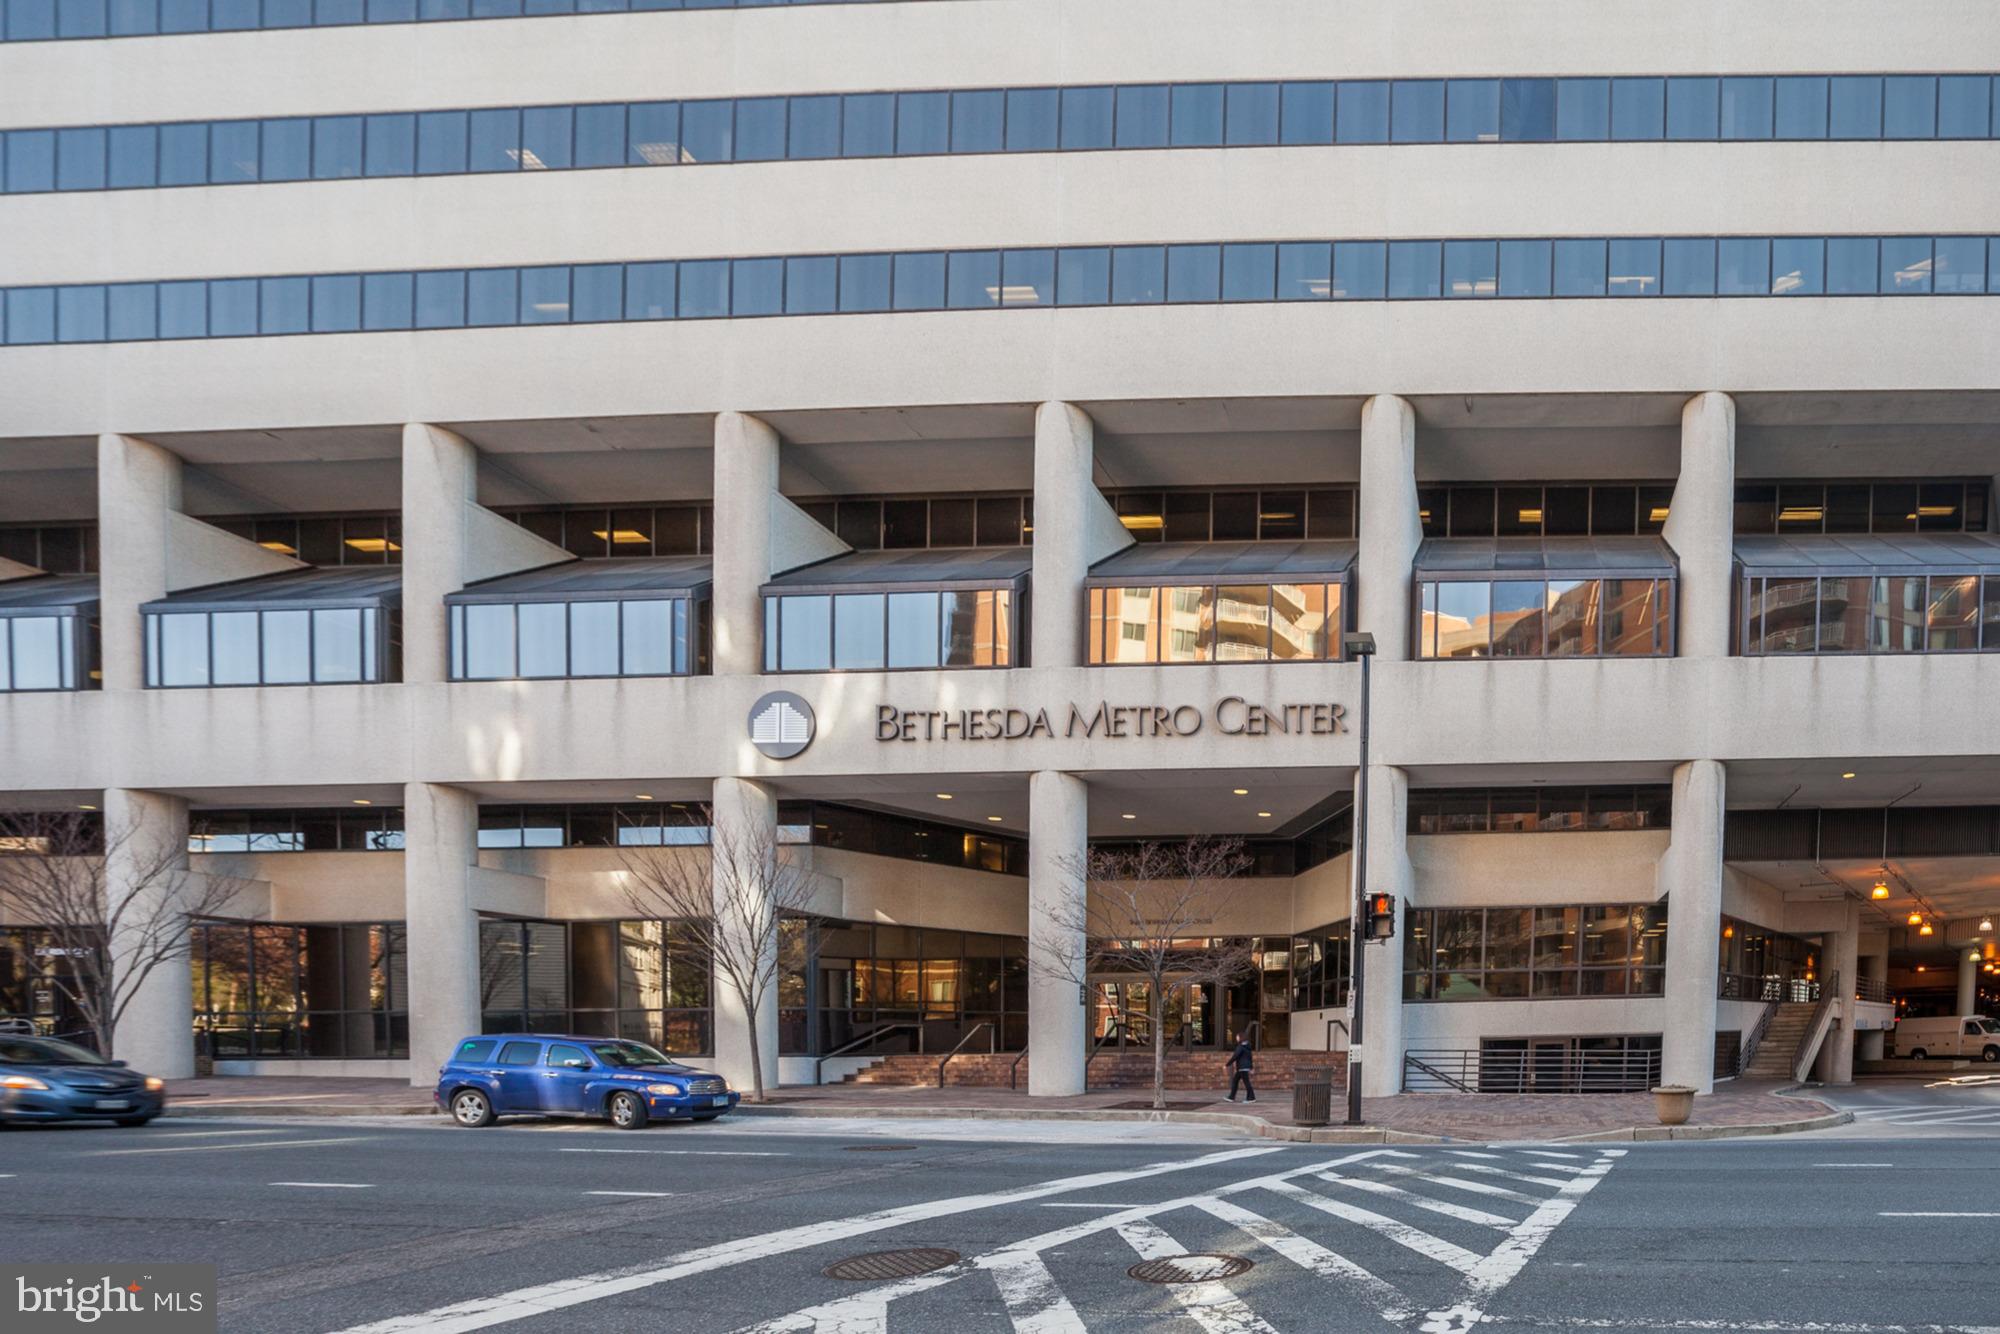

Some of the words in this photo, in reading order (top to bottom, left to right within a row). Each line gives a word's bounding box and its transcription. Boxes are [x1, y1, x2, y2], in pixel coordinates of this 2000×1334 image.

[875, 704, 1054, 742] BETHESDA
[1065, 700, 1201, 738] METRO
[1215, 695, 1348, 735] CENTER
